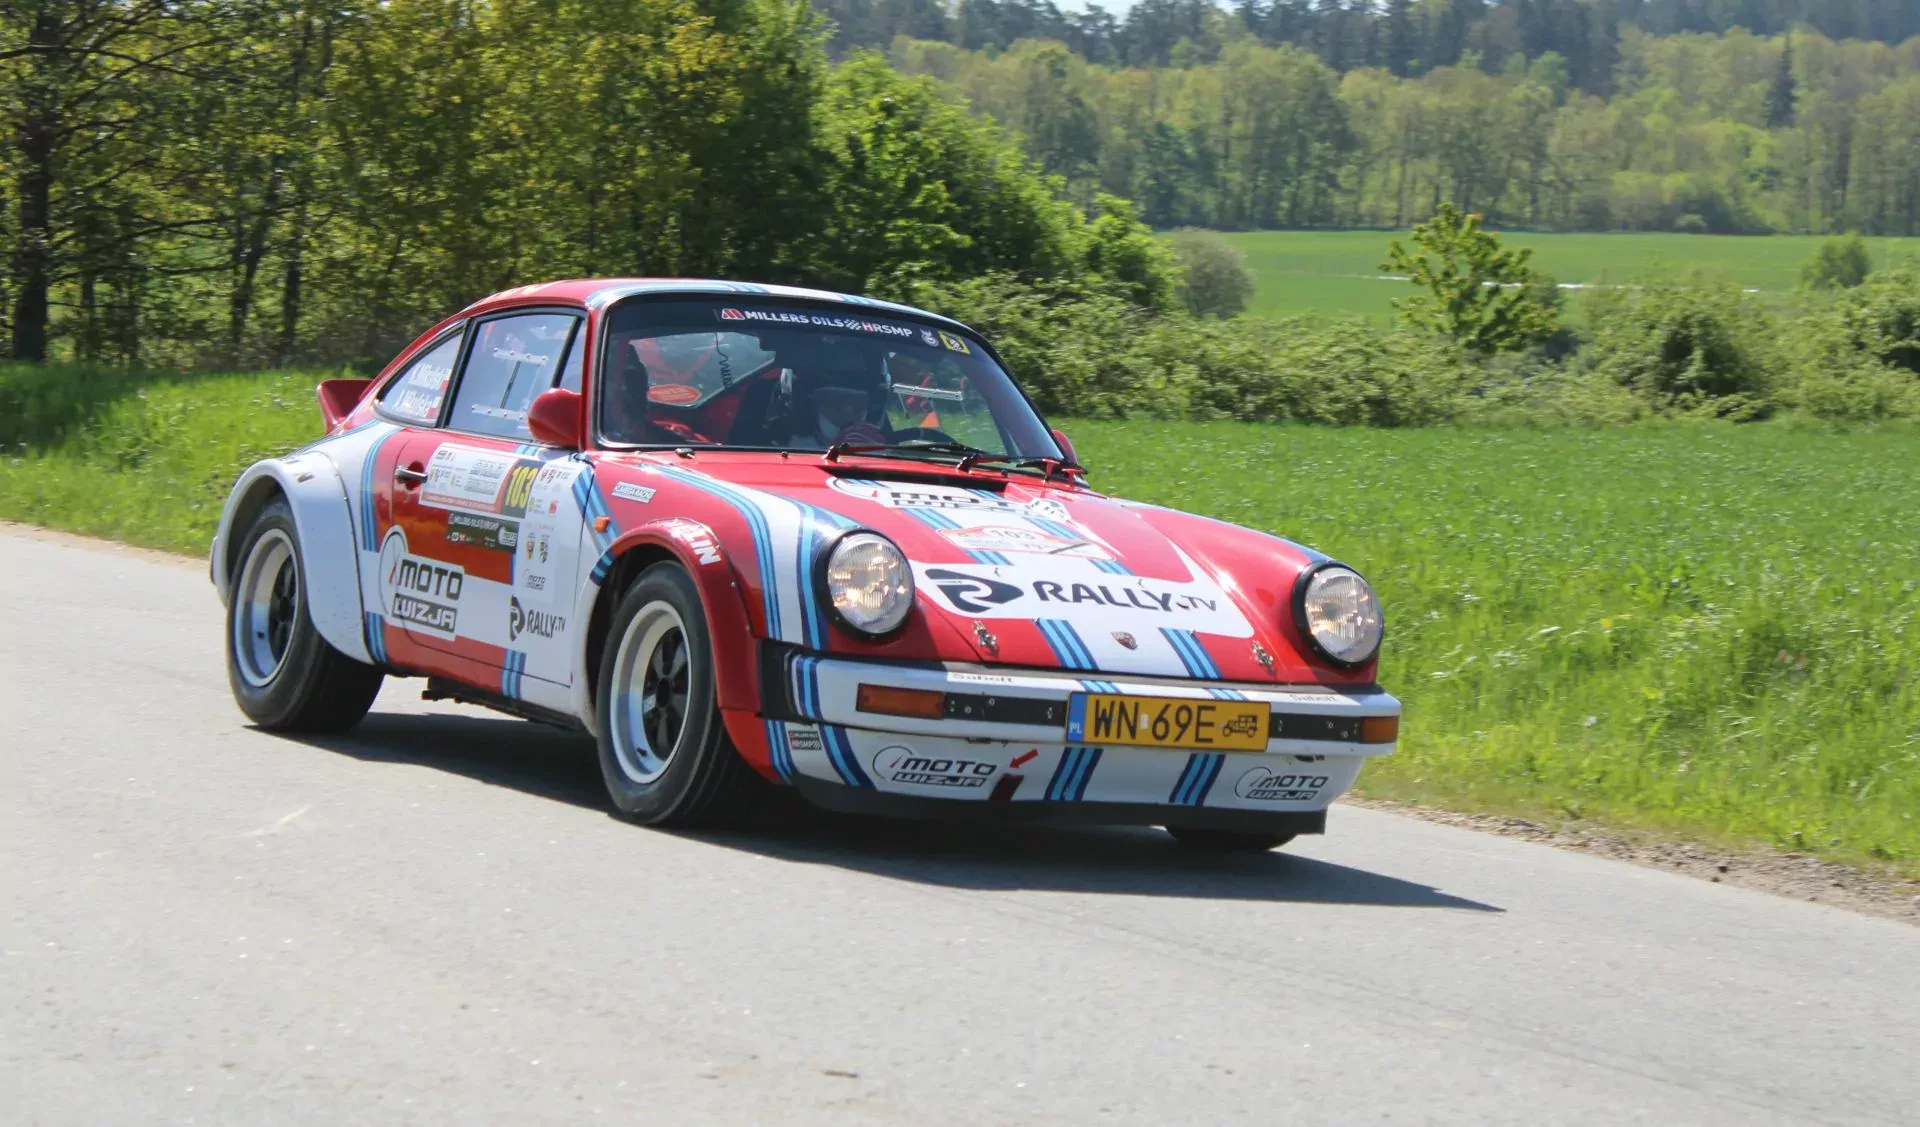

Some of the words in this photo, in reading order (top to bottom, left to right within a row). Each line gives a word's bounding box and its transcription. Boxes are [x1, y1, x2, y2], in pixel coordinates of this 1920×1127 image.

[744, 310, 809, 324] MILLERS
[812, 315, 844, 328] OILS
[862, 322, 912, 338] HRSMP
[505, 466, 539, 510] 103
[988, 527, 1037, 541] 103
[399, 559, 464, 601] MOTO
[1069, 722, 1082, 734] PL
[1094, 699, 1140, 740] WN
[1152, 703, 1216, 744] 69E
[901, 758, 997, 776] MOTO
[892, 772, 987, 787] WIZJA
[1257, 775, 1329, 788] MOTO
